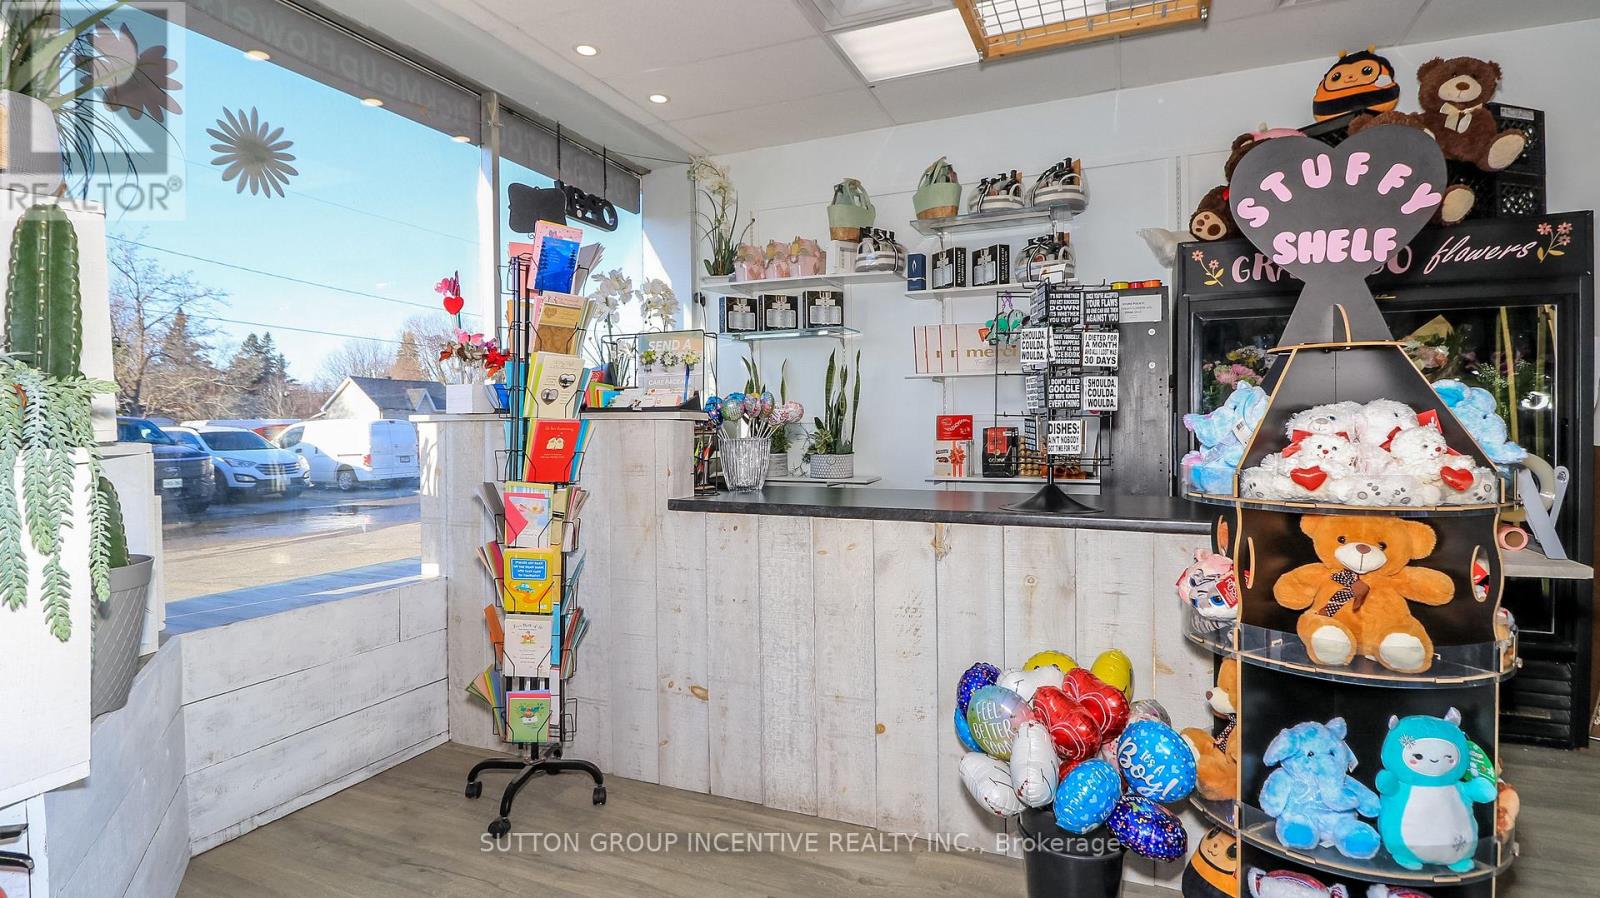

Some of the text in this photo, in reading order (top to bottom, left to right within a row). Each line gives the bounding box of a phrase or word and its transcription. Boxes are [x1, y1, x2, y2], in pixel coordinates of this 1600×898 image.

[1236, 151, 1442, 228] STUFFY
[1273, 227, 1398, 265] SHELF
[1423, 234, 1539, 277] flowers
[1087, 299, 1119, 308] YOUR FLAWS
[1087, 313, 1119, 322] AGAINST YOU
[1022, 331, 1046, 339] SHOULDA.
[649, 338, 692, 351] SEND A
[1022, 341, 1045, 350] COULDA.
[966, 345, 1017, 358] merci
[1022, 351, 1045, 360] WOULDA.
[1084, 356, 1117, 364] 30 DAYS
[1088, 379, 1116, 387] SHOULDA.
[1049, 385, 1080, 393] GOOGLE
[1088, 389, 1116, 397] COULDA.
[1049, 400, 1080, 408] EVERYTHING
[1088, 399, 1116, 407] WOULDA.
[1048, 423, 1080, 434] DISHES:
[975, 701, 1001, 722] FEEL
[973, 718, 1016, 740] BETTER
